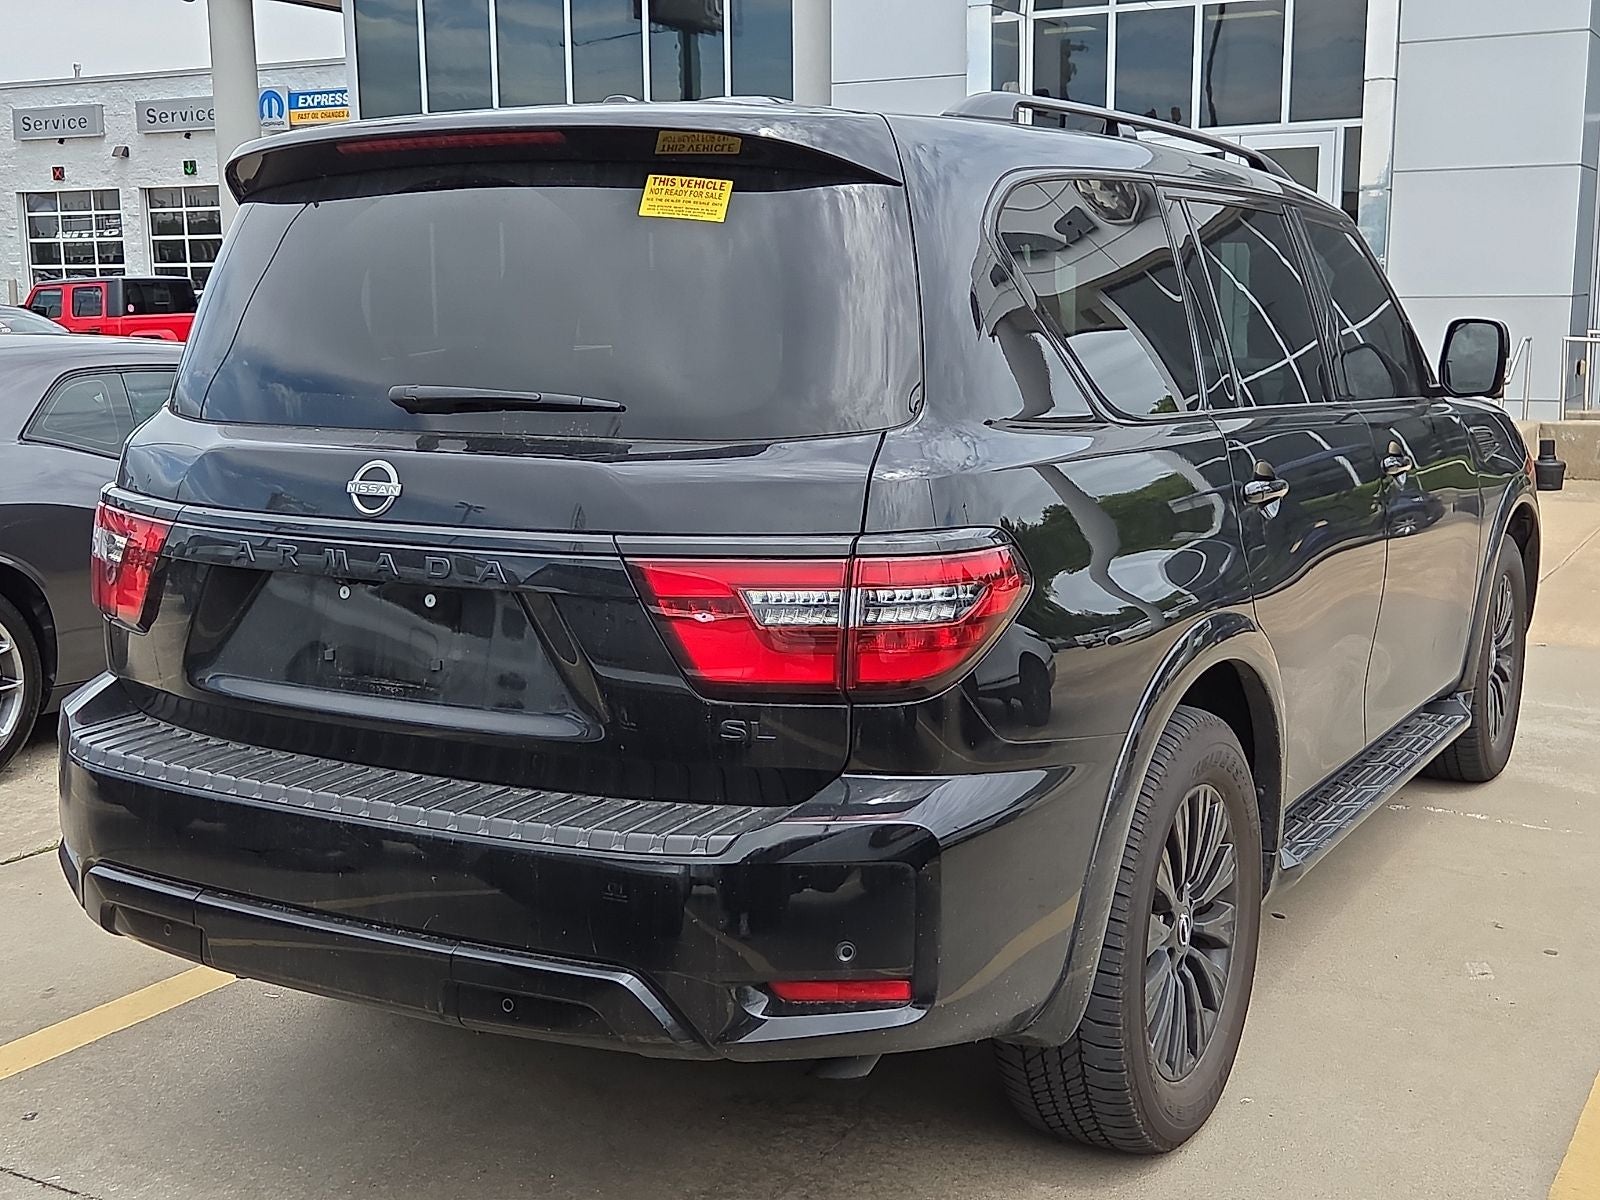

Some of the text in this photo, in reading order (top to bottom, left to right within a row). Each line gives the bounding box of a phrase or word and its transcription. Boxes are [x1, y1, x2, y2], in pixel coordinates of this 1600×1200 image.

[298, 93, 349, 107] EXPRESS
[146, 105, 214, 124] Service
[21, 114, 88, 132] Service
[652, 176, 727, 191] THIS VEHICLE
[649, 187, 724, 200] NOT READY FOR SALE
[348, 482, 401, 495] NISSAN
[232, 540, 508, 584] ARMADA
[719, 719, 777, 740] SL
